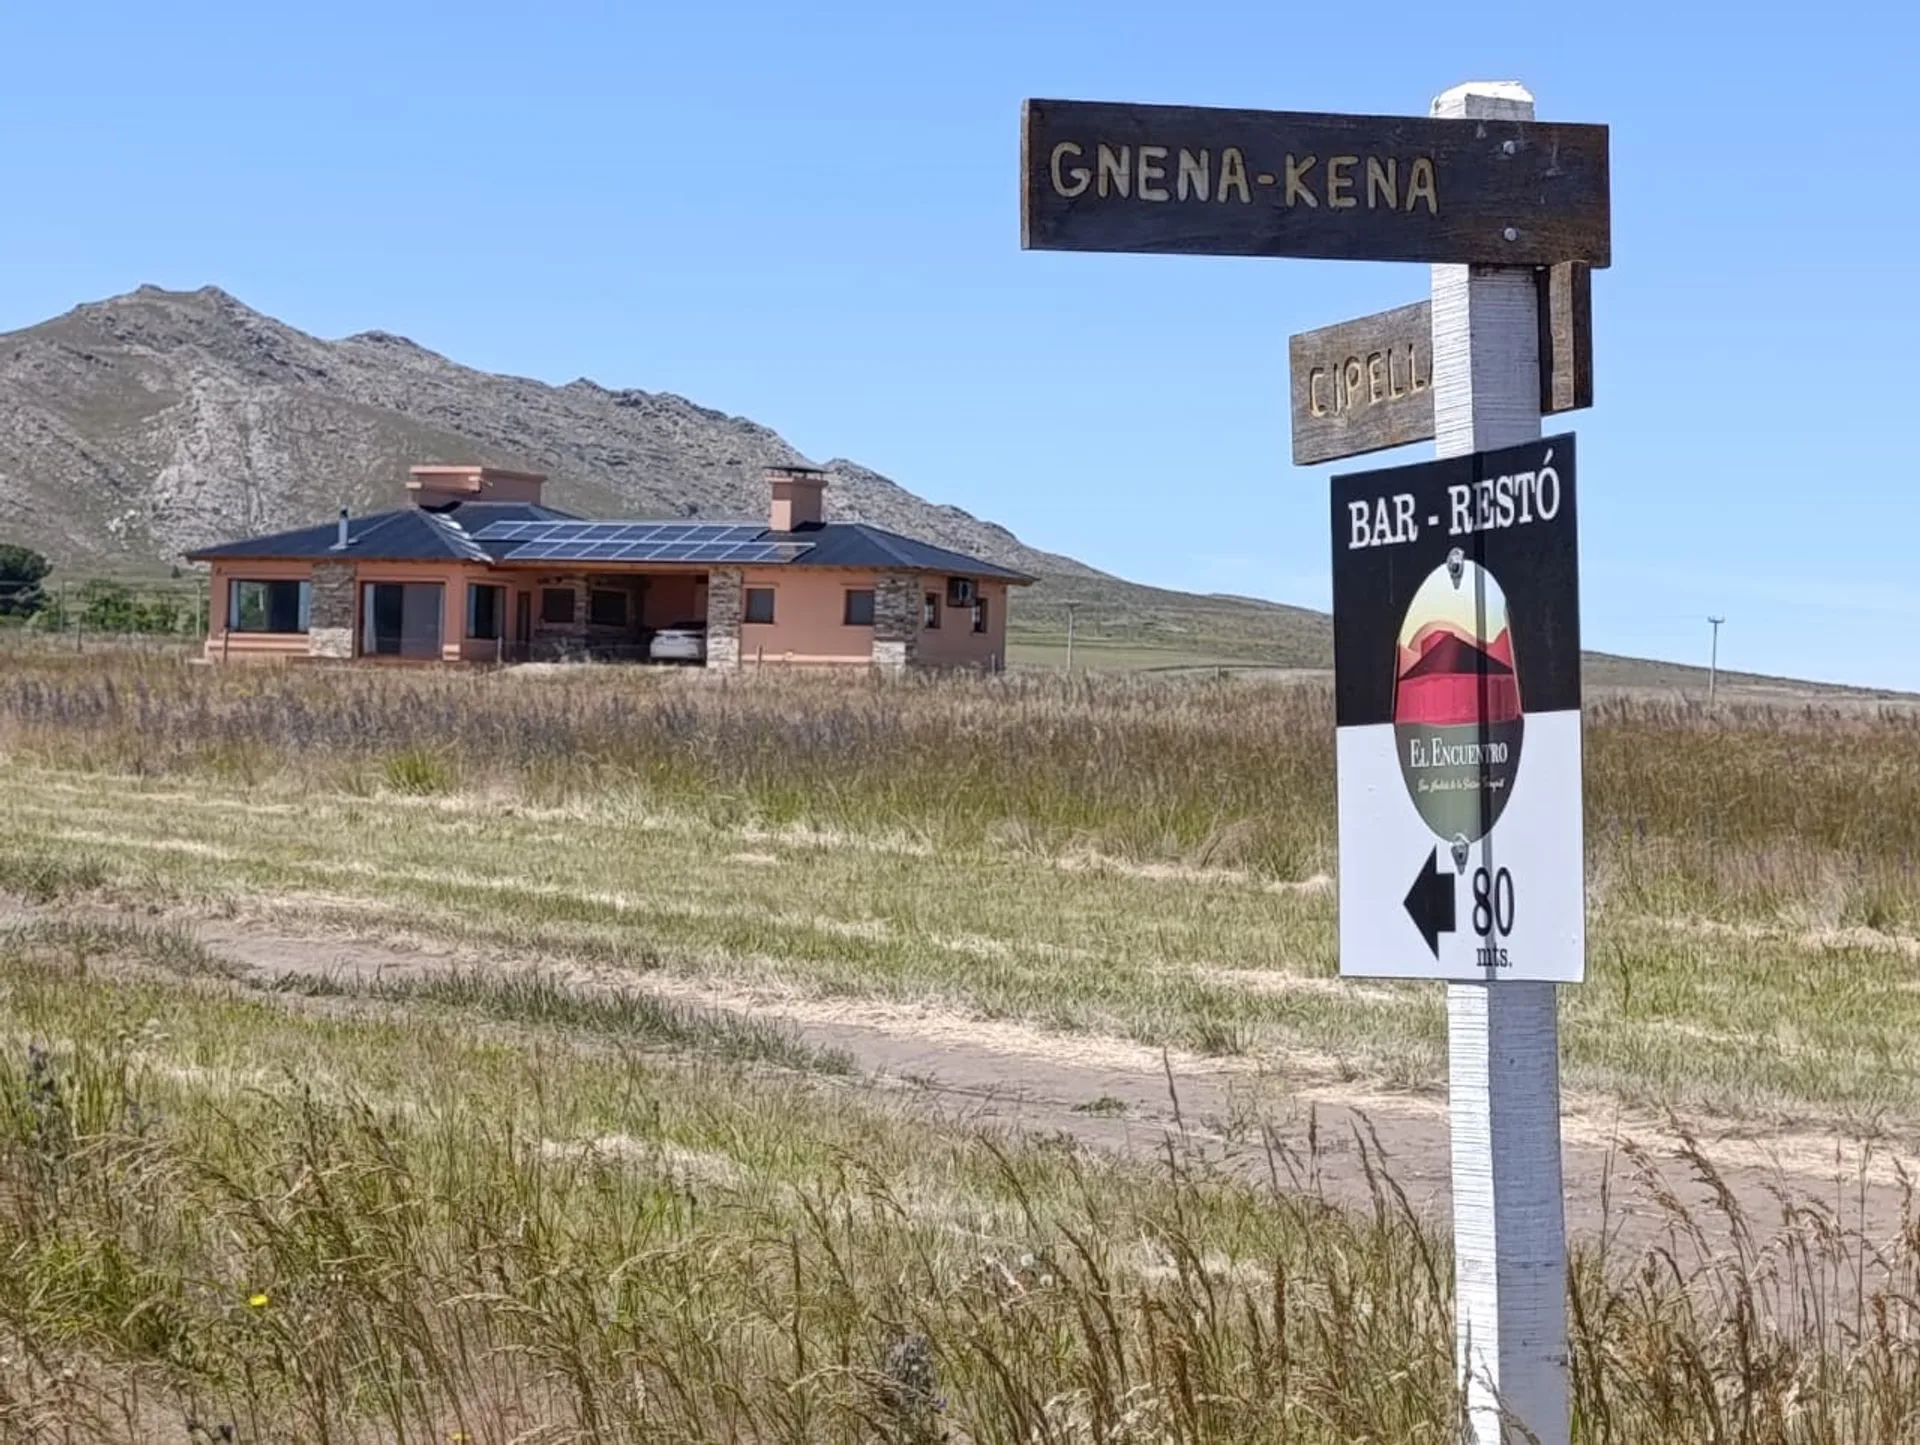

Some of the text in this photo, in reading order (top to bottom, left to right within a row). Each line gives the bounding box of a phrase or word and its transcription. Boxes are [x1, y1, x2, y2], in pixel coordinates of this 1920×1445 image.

[1049, 141, 1439, 215] GNENA-KENA
[1309, 342, 1433, 417] CIPELL
[1348, 493, 1419, 550] BAR
[1447, 448, 1561, 536] RESTÓ
[1472, 866, 1516, 938] 80
[1475, 945, 1513, 968] mts.
